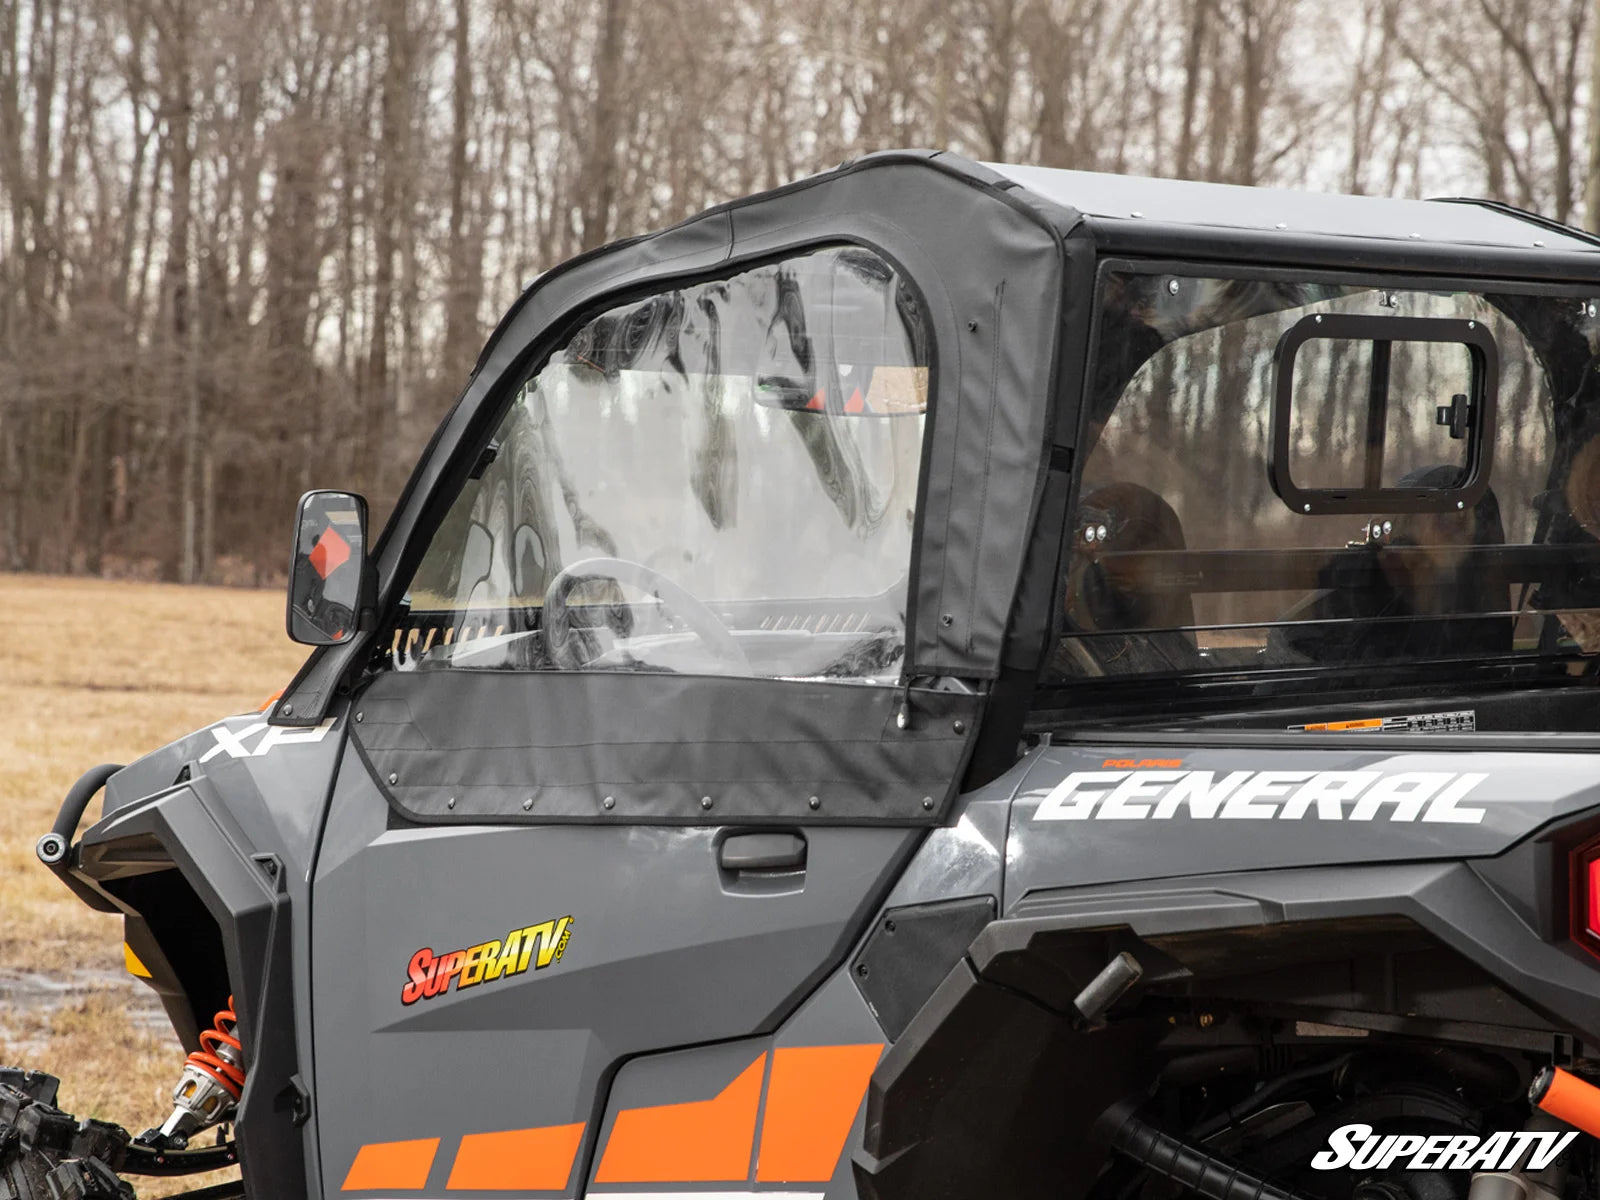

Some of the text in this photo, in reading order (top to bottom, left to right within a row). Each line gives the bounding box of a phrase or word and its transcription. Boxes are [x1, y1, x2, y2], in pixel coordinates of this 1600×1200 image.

[199, 717, 338, 764] XP
[1102, 758, 1183, 769] POLARIS
[1032, 770, 1490, 824] GENERAL
[401, 915, 571, 1006] SUPERATV
